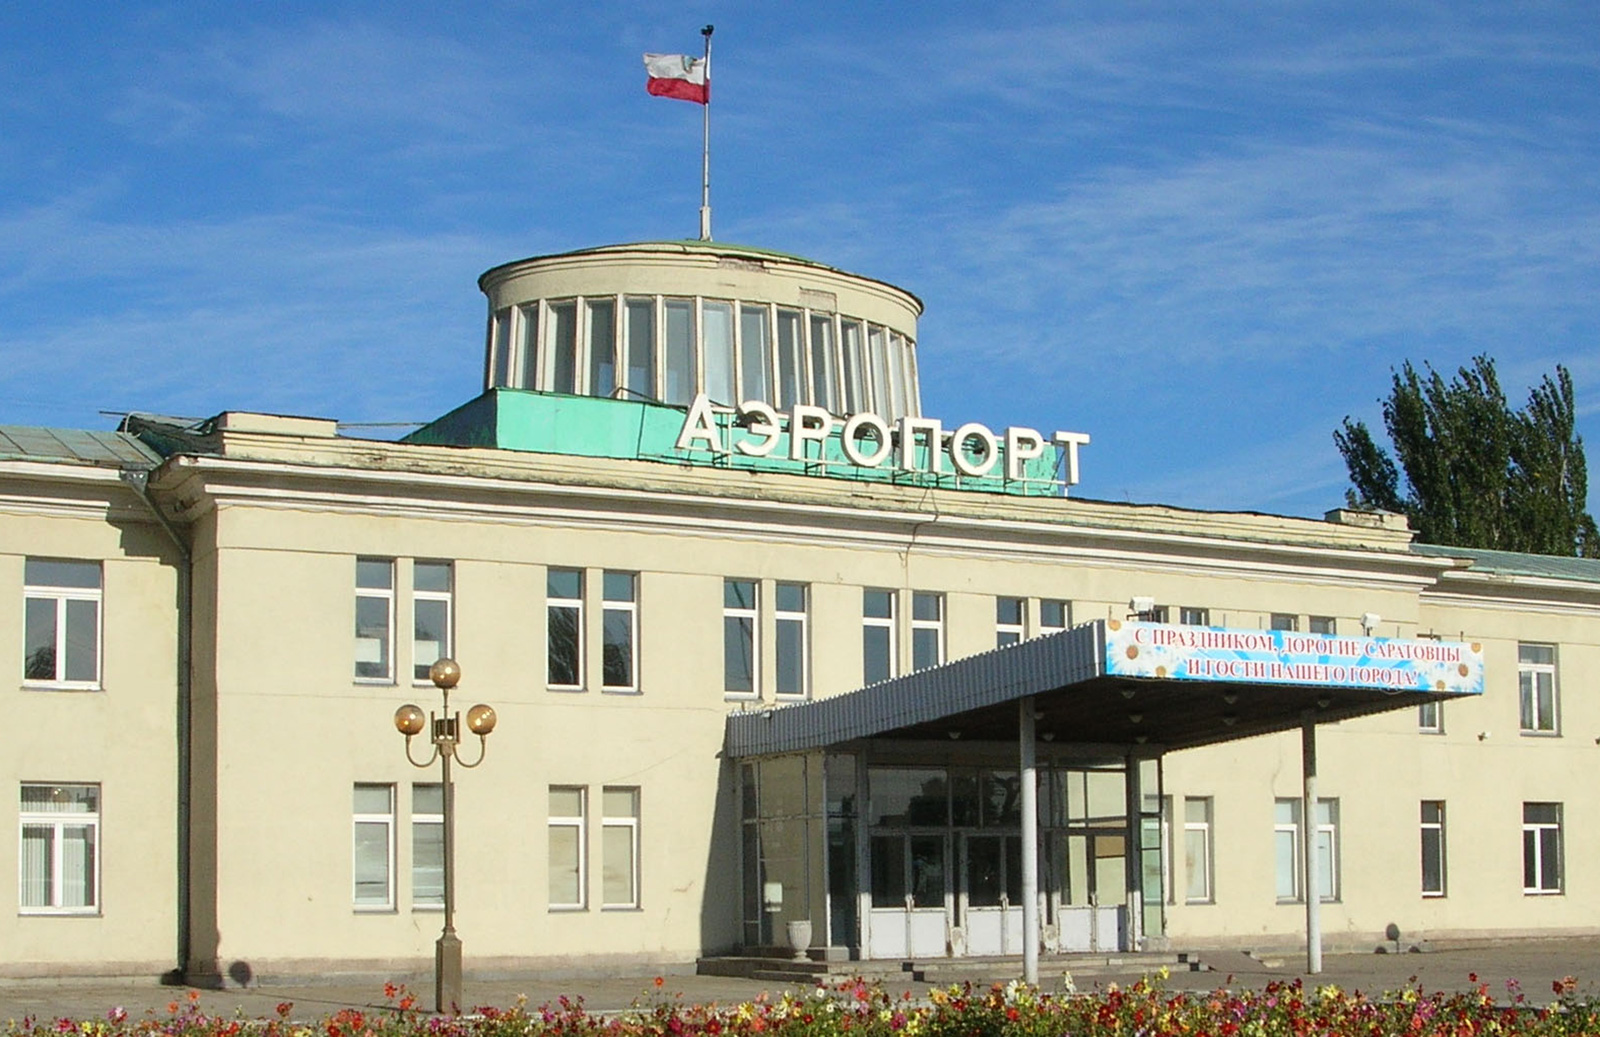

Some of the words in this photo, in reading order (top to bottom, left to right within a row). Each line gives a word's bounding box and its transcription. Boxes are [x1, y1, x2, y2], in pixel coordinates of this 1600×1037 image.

[674, 393, 1091, 485] АЭРОПОРТ
[1135, 628, 1148, 645] С
[1153, 629, 1278, 653] ПРАЗДНИКОМ,
[1282, 637, 1360, 657] ДОРОГИЕ
[1365, 642, 1461, 663] САРАТОВЦЫ
[1188, 659, 1200, 675] И
[1207, 660, 1266, 678] ГОСТИ
[1271, 662, 1345, 682] НАШЕГО
[1350, 668, 1418, 686] ГОРОДА!
